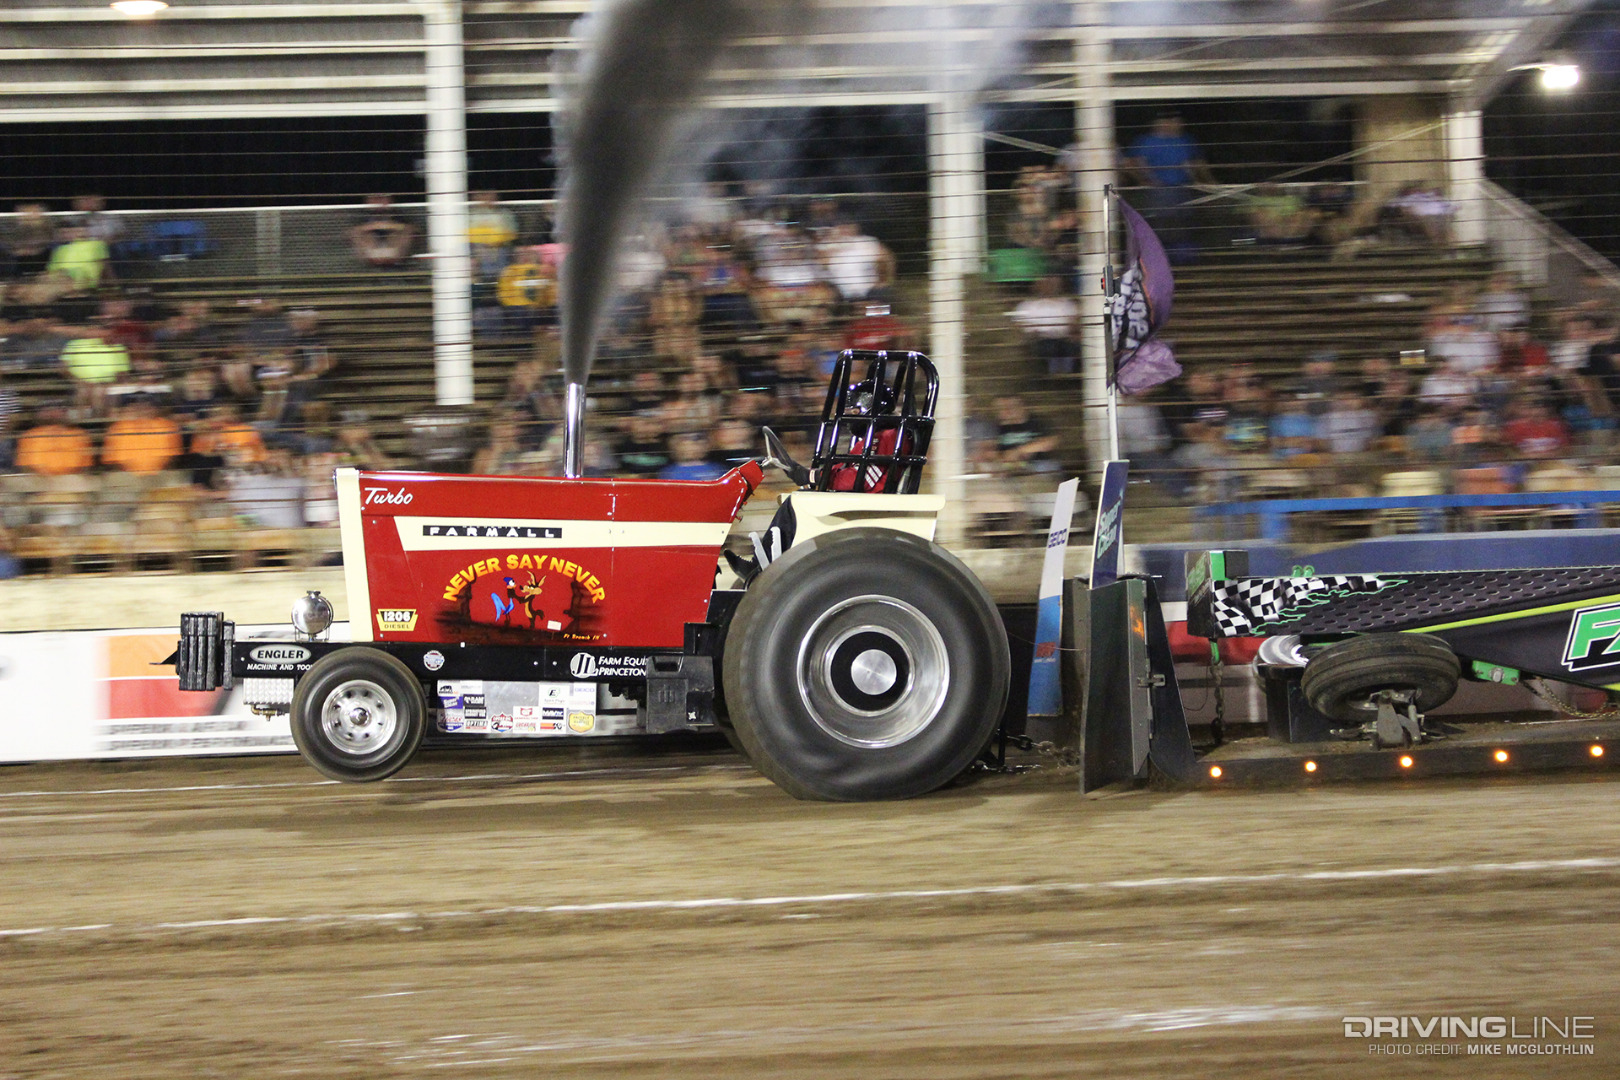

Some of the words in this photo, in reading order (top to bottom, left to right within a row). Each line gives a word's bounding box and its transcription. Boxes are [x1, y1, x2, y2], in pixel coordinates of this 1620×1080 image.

[364, 487, 413, 505] Turbo
[429, 526, 554, 538] FARMALL
[1048, 528, 1068, 549] GEICO
[443, 557, 502, 602] NEVER
[506, 554, 548, 570] SAY
[549, 556, 606, 604] NEVER
[383, 610, 411, 622] 1206
[257, 650, 304, 659] ENGLER
[598, 655, 621, 666] FARM
[623, 655, 647, 666] EQUI
[246, 663, 278, 671] MACHINE
[279, 663, 294, 671] AND
[598, 666, 647, 677] PRINCETON
